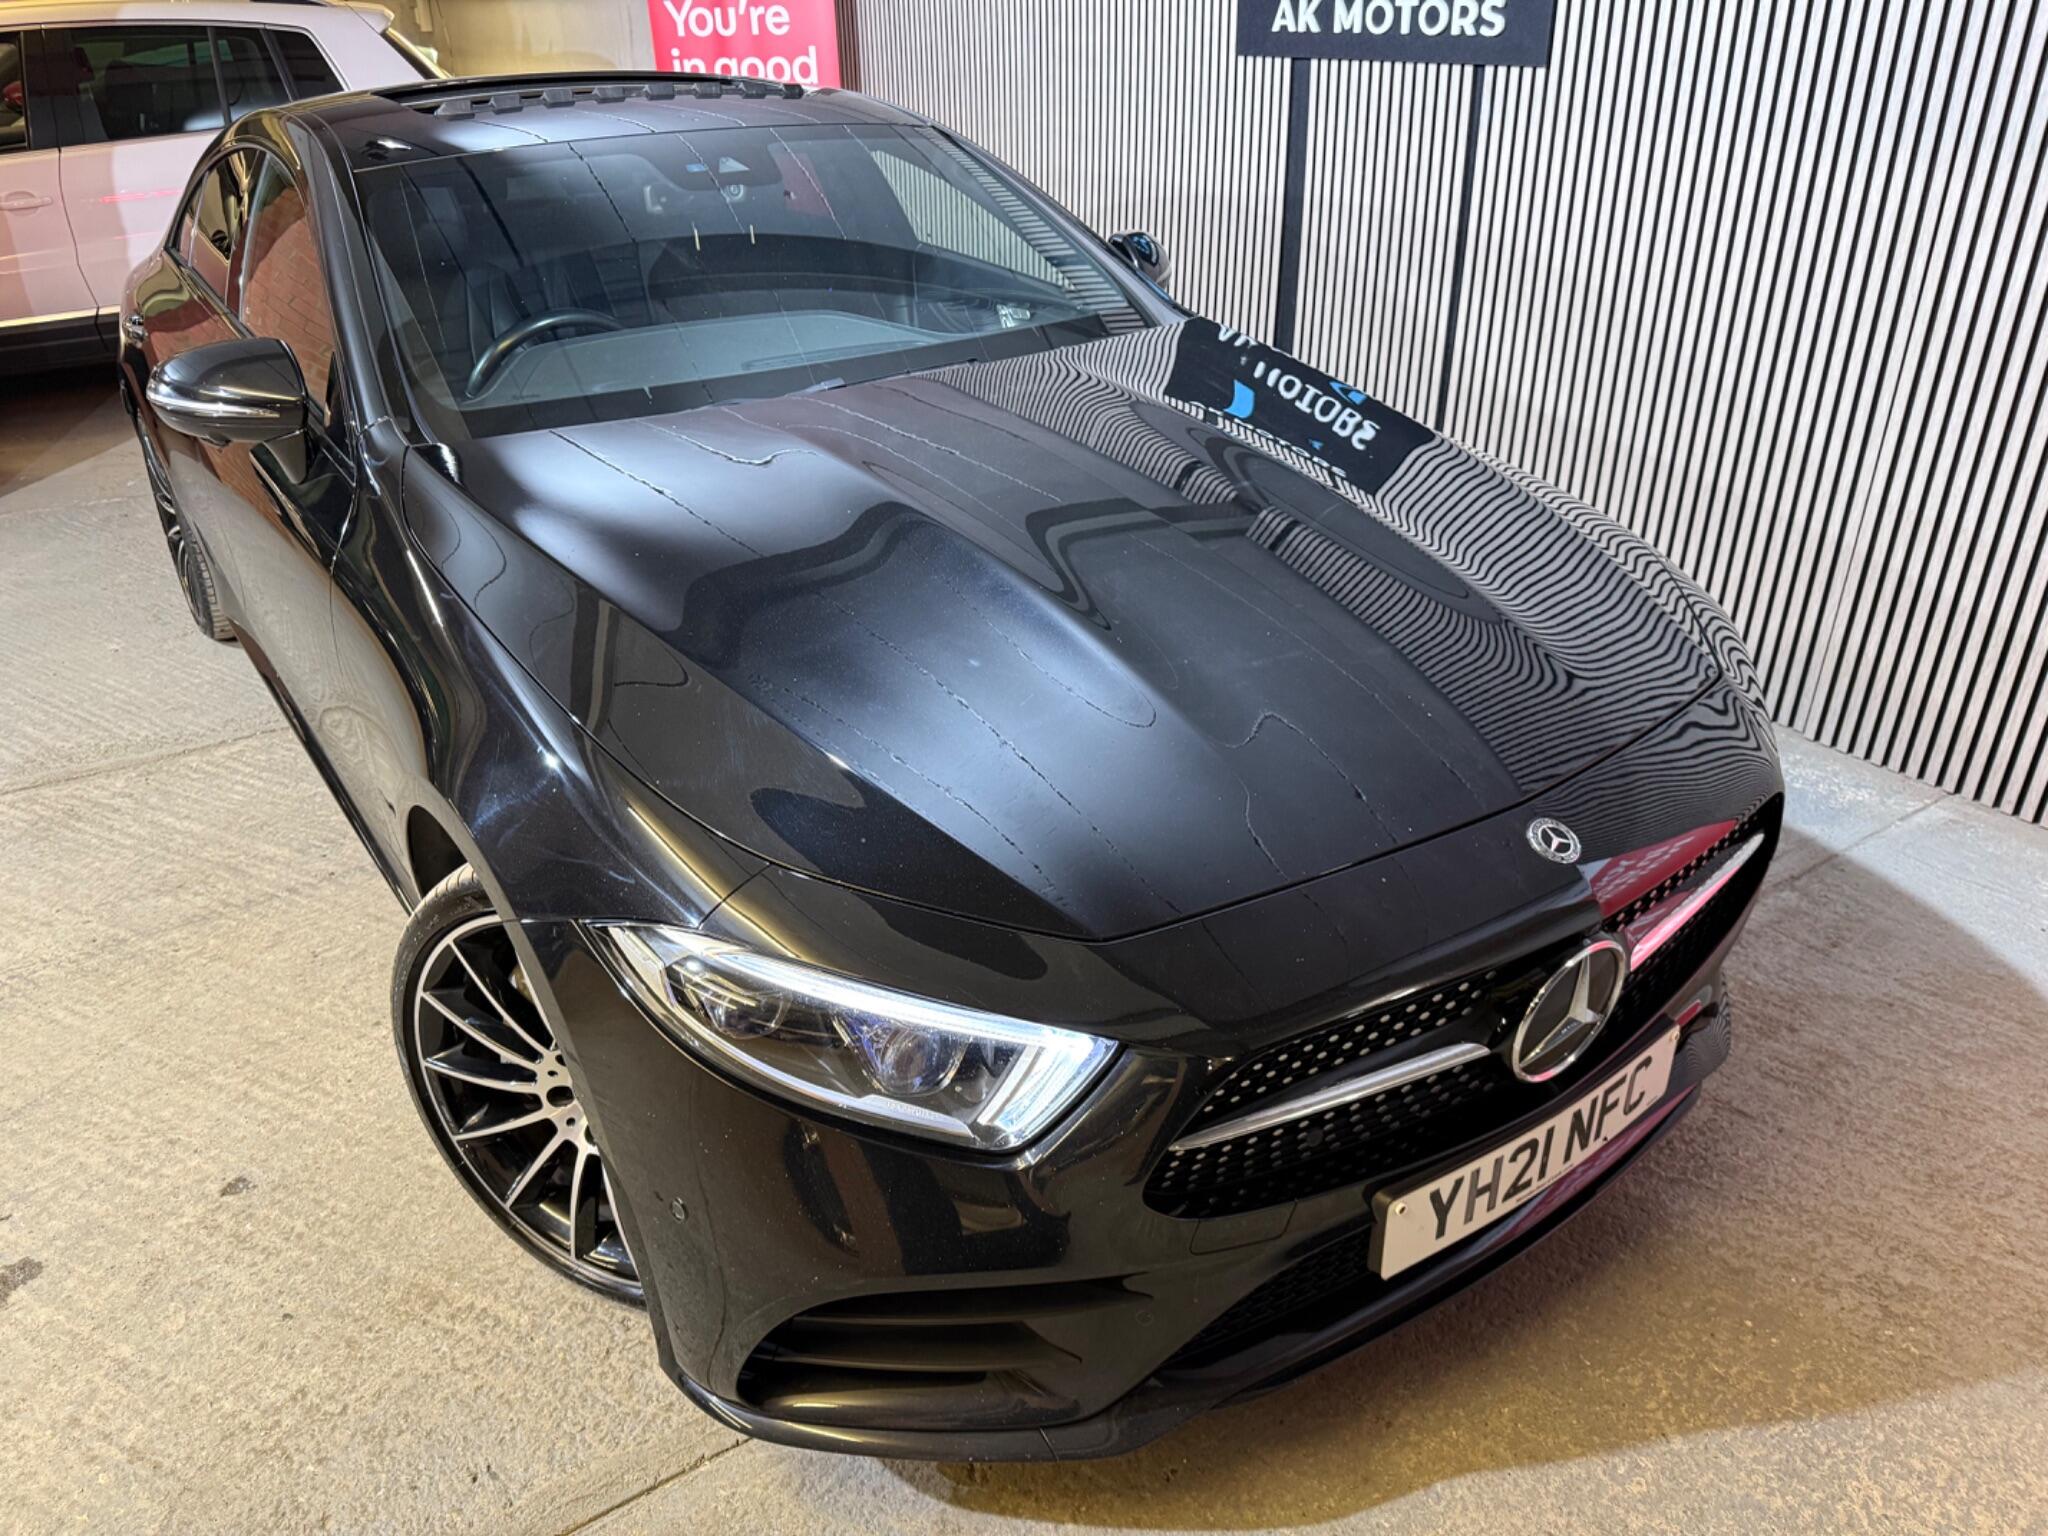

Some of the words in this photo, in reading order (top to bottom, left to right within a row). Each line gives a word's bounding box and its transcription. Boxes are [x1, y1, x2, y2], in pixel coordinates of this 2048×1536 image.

[663, 0, 791, 37] You're
[1271, 0, 1321, 33] AK
[1333, 0, 1507, 37] MOTORS
[714, 45, 819, 84] good
[1429, 1125, 1555, 1240] YH21
[1563, 1055, 1653, 1165] NFC
